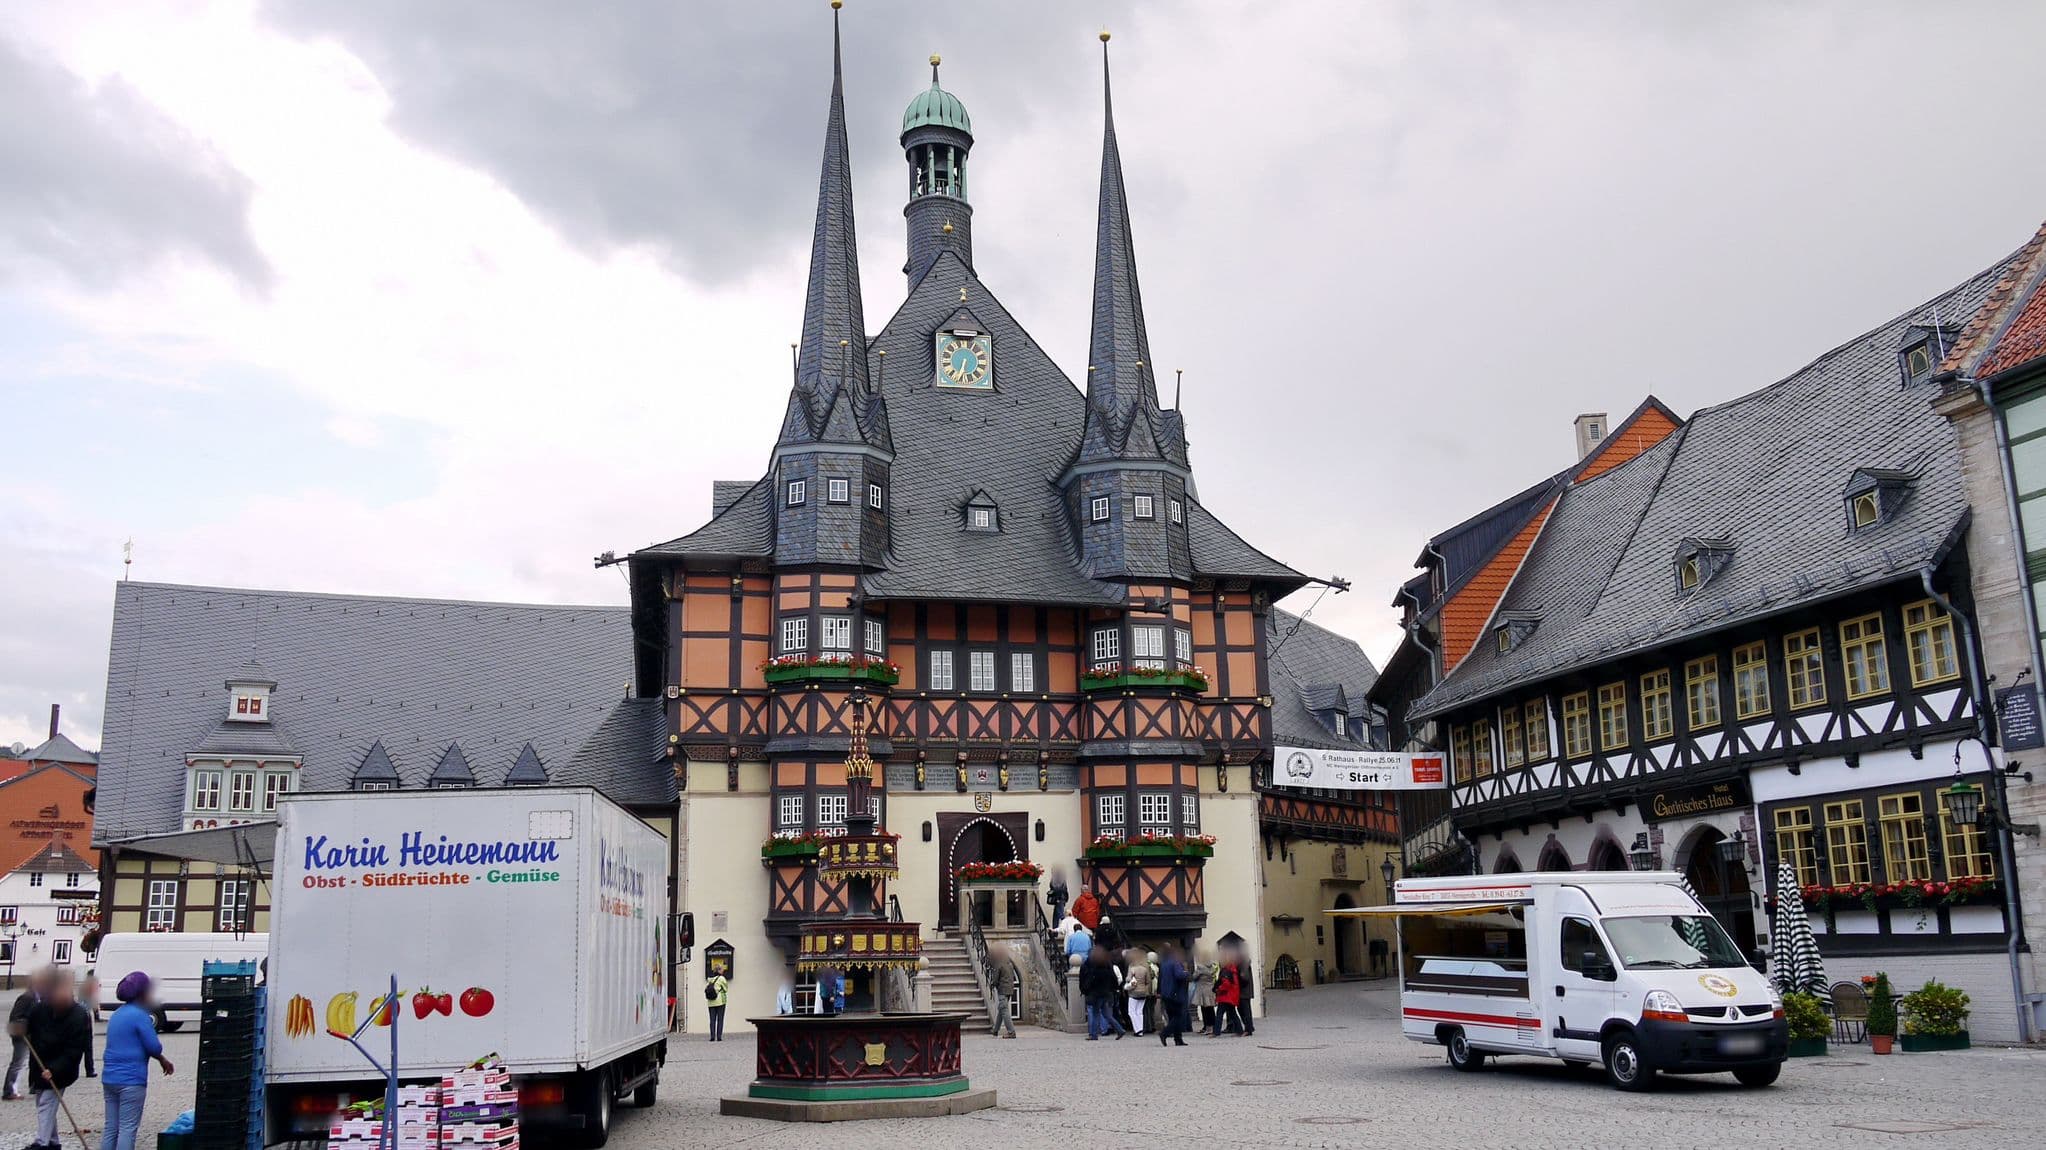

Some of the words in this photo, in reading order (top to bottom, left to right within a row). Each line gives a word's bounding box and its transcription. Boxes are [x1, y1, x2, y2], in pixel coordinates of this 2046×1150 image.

[1328, 754, 1355, 763] Rathaus
[1359, 756, 1378, 765] Rallye
[1349, 772, 1379, 783] Start
[1713, 783, 1729, 793] Hotel
[1708, 793, 1734, 809] Haus
[304, 835, 390, 870] Karin
[399, 831, 560, 867] Heinemann
[302, 875, 347, 889] Obst
[362, 872, 471, 888] Südfrüchte
[486, 868, 561, 884] Gemüse
